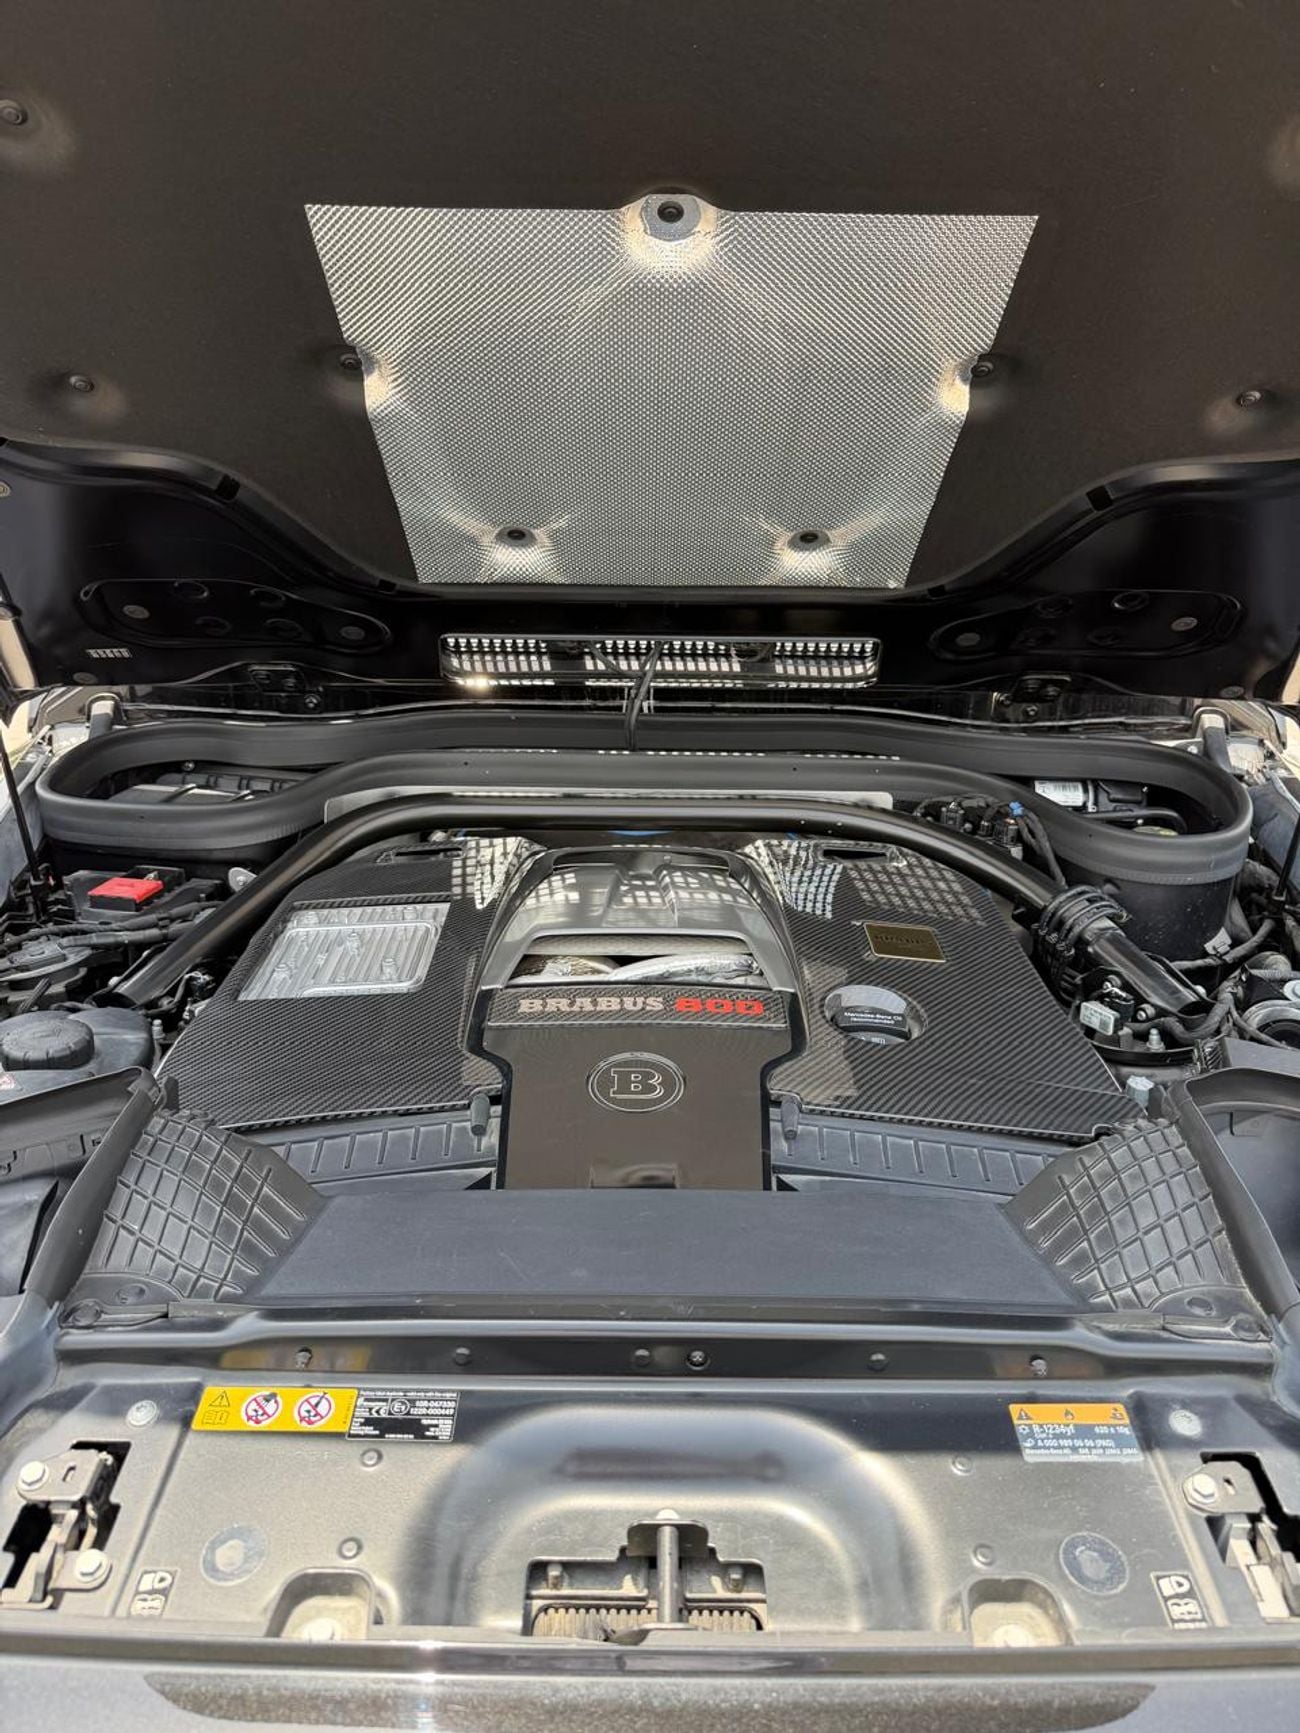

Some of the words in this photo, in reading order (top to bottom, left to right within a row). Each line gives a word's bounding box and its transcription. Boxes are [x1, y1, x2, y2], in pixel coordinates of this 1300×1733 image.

[518, 997, 664, 1013] BRABUS
[675, 996, 764, 1016] 800
[610, 1068, 664, 1099] B
